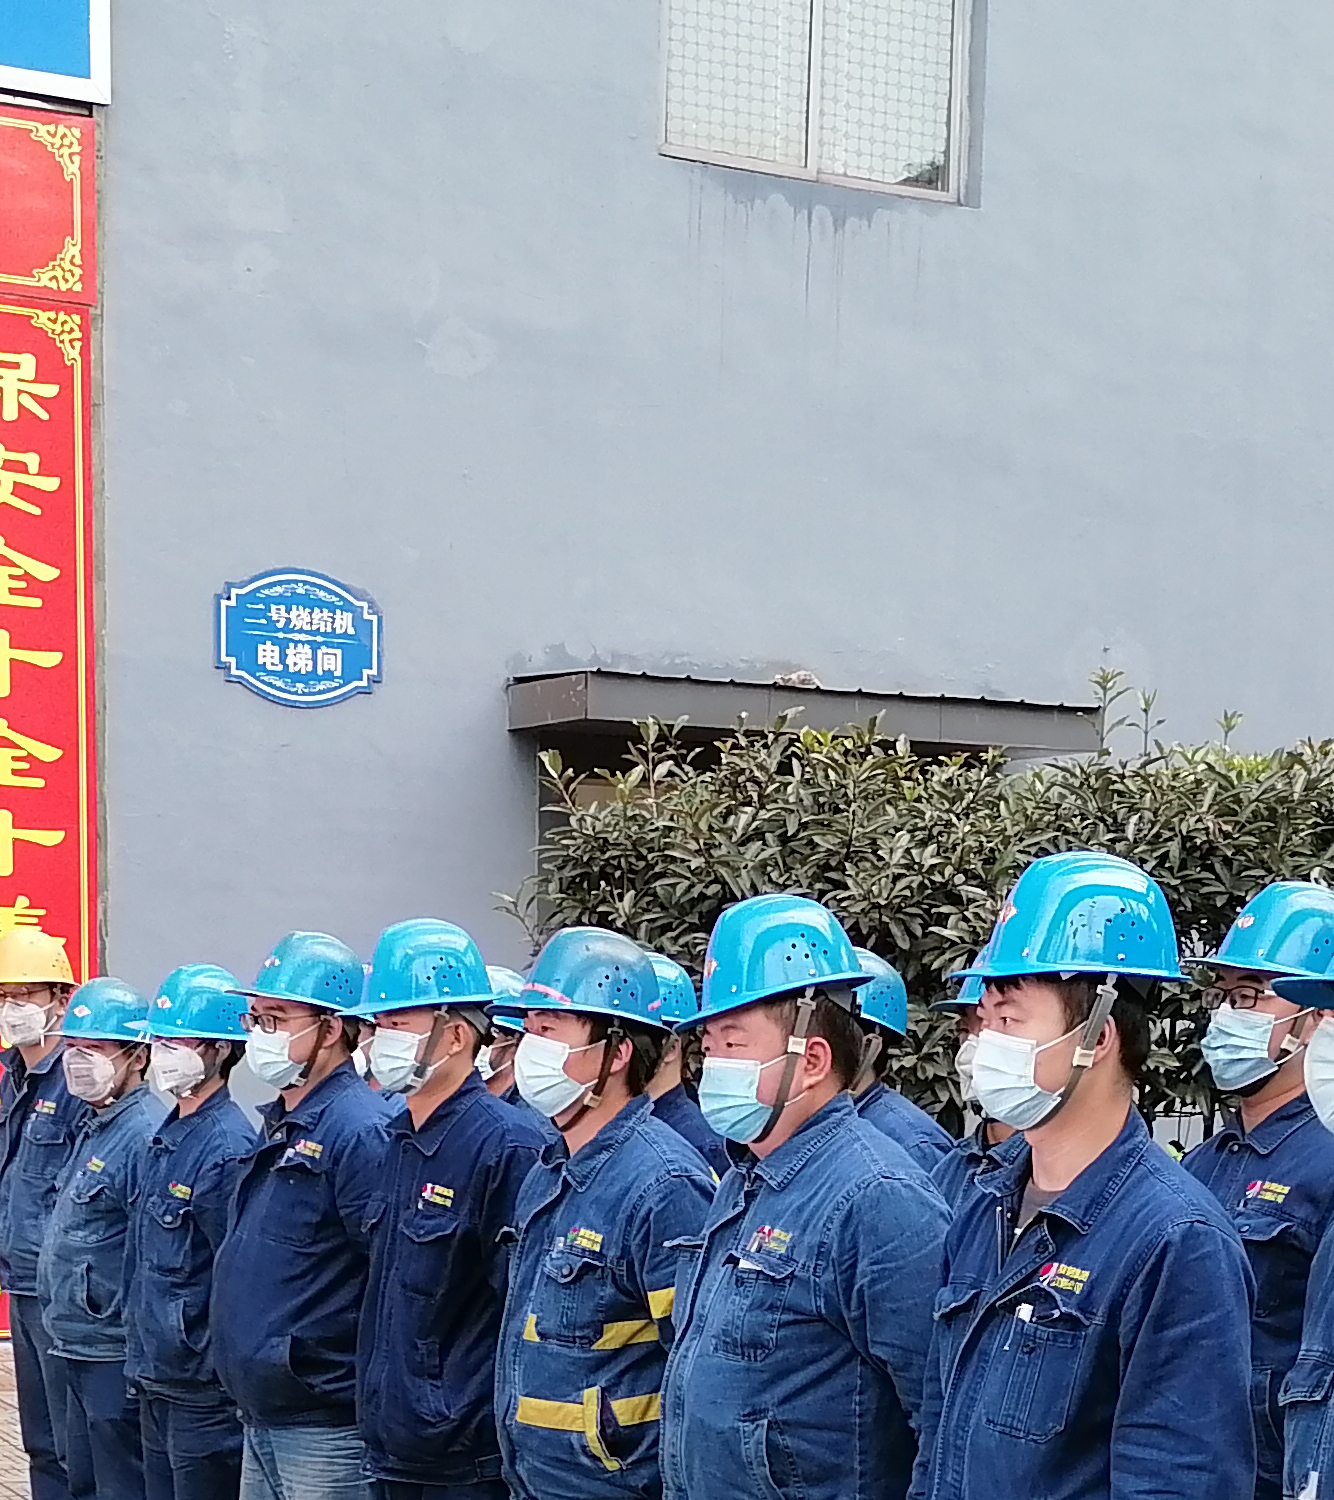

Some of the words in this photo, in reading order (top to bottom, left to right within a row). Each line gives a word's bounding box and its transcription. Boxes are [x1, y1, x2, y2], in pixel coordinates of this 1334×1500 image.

[243, 603, 356, 635] 二号烧结机
[257, 640, 343, 677] 电梯间
